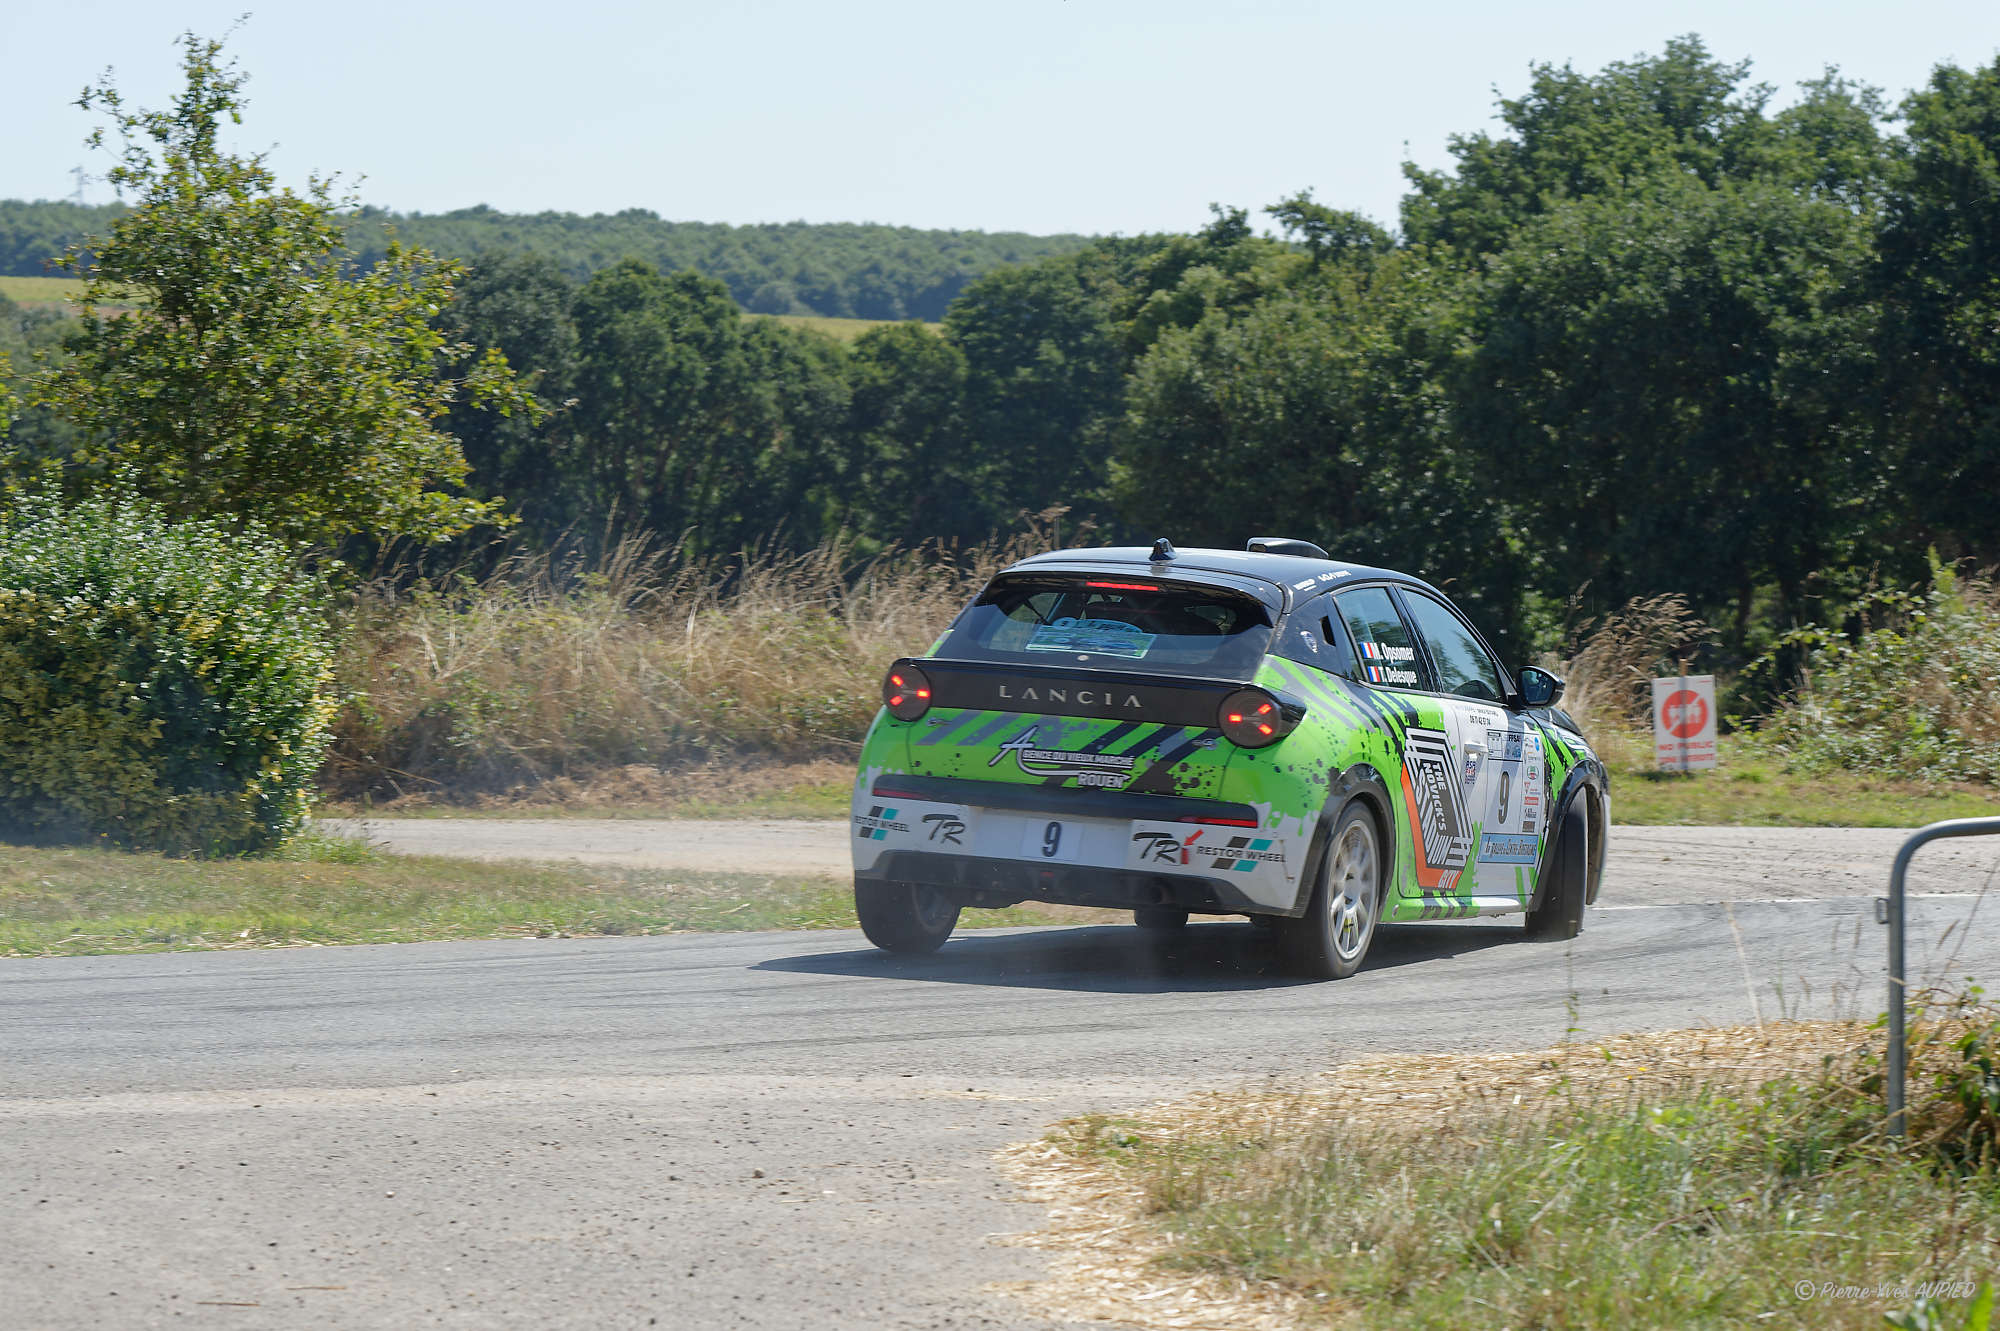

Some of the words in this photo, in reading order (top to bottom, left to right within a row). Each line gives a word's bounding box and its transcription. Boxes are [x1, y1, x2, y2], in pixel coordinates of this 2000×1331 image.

[1381, 642, 1415, 664] Opsomer
[1377, 666, 1388, 682] T.
[1385, 666, 1417, 687] Delesque
[999, 685, 1144, 708] LANCIA
[1053, 751, 1065, 761] DU
[1067, 752, 1094, 763] VIEUX
[1077, 773, 1124, 788] ROUEN
[1432, 763, 1447, 791] THE
[1423, 763, 1447, 831] NOVICK'S
[1498, 770, 1510, 825] 9
[1041, 821, 1062, 857] 9
[1196, 845, 1244, 858] RESTOR
[1246, 850, 1286, 863] WHEEL
